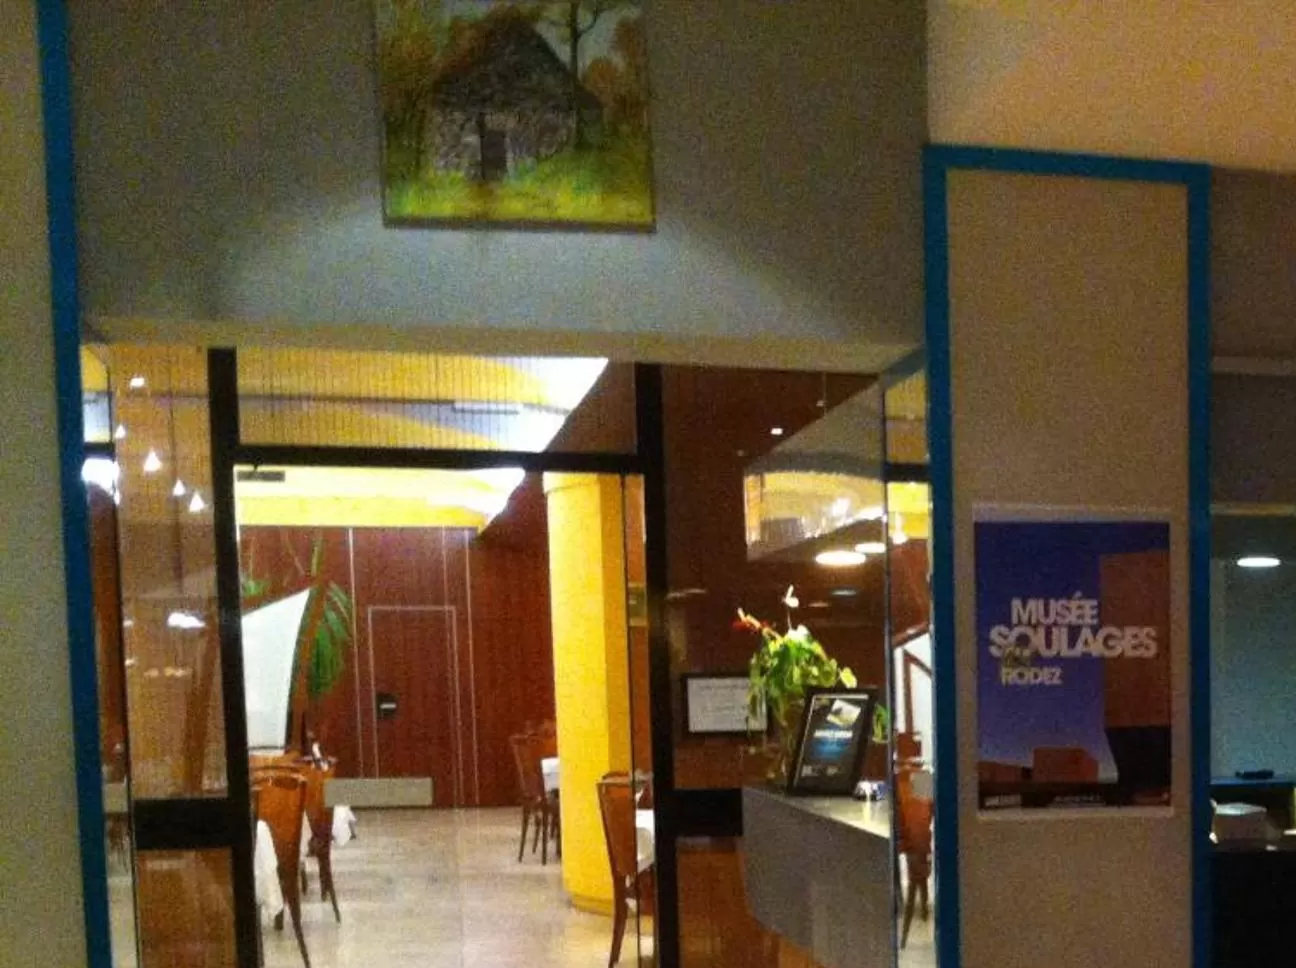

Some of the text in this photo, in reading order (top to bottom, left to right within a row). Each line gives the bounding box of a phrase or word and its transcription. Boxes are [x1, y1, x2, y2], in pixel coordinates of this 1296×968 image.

[1010, 591, 1099, 626] MUSÉE
[988, 624, 1158, 659] SOULAGES
[1000, 666, 1063, 686] RODEZ
